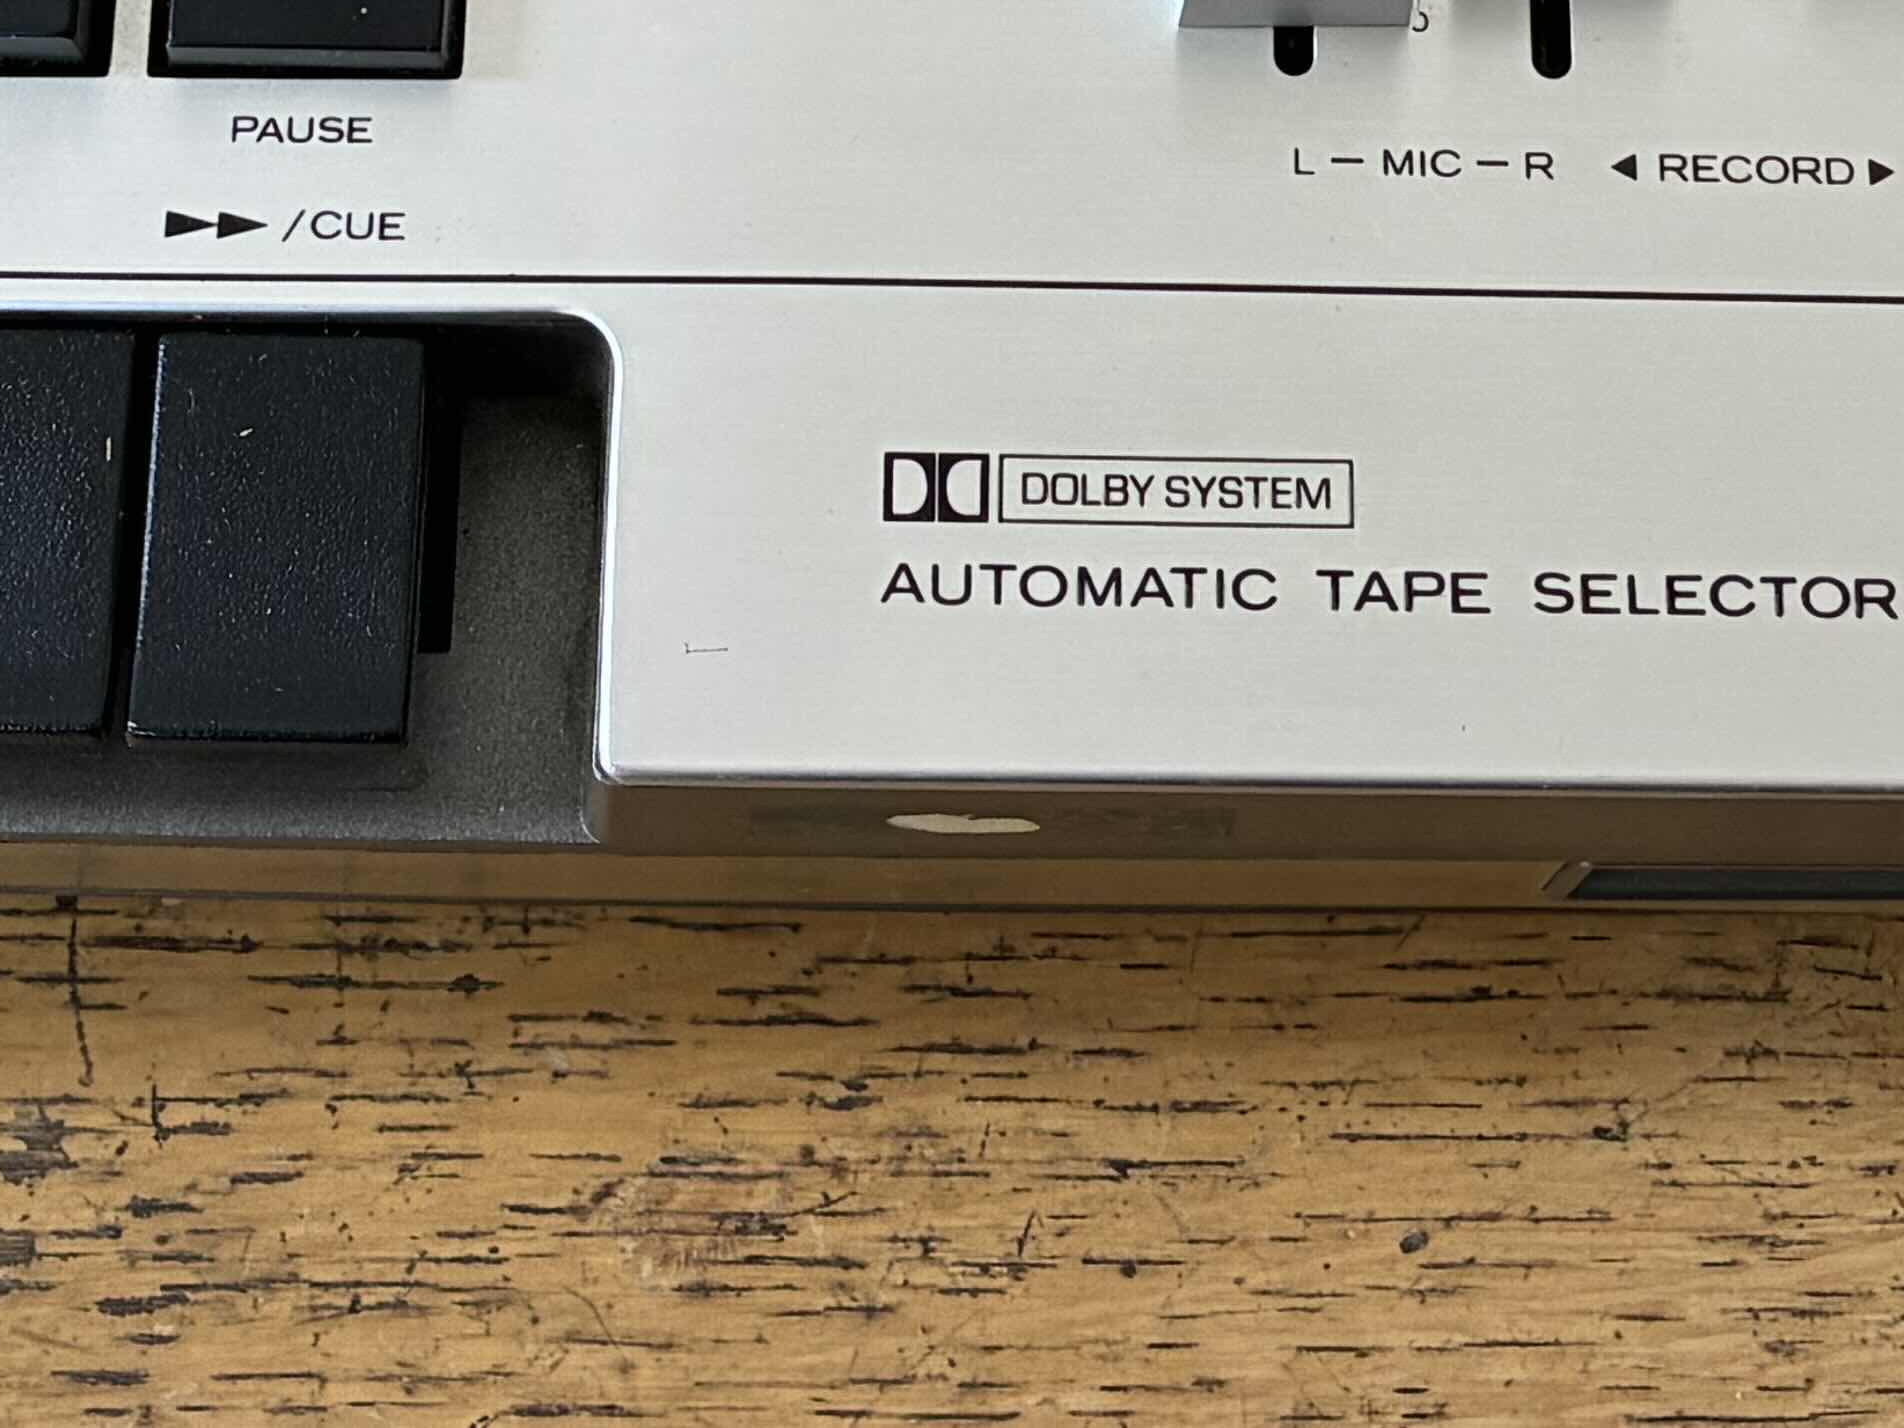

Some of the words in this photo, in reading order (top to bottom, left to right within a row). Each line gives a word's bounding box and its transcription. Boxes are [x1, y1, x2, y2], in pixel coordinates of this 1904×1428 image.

[231, 115, 373, 144] PAUSE
[1658, 153, 1855, 185] RECORD
[1021, 472, 1155, 507] DOLBY
[1165, 475, 1331, 510] SYSTEM
[880, 562, 1278, 611] AUTOMATIC
[1315, 569, 1491, 614] TAPE
[1534, 572, 1899, 620] SELECTOR
